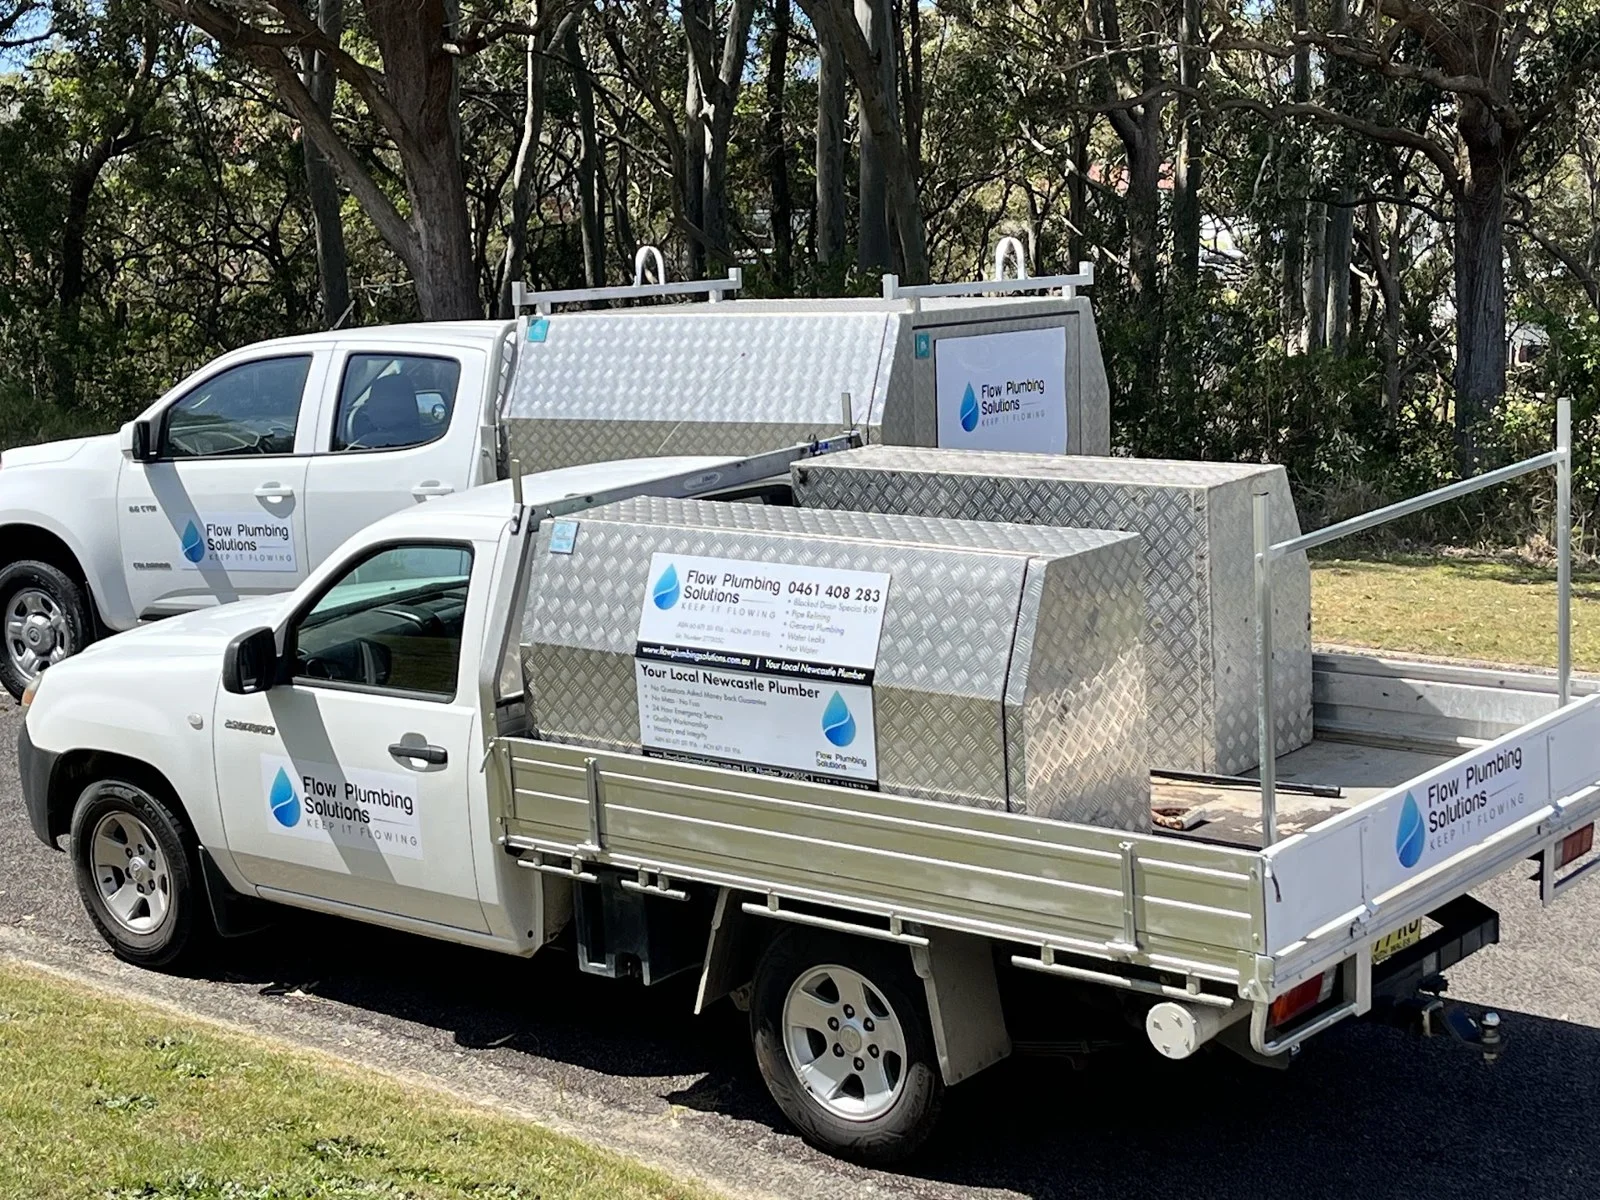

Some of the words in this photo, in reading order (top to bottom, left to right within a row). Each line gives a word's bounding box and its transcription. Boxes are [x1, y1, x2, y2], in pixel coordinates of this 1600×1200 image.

[981, 384, 1002, 399] Flow
[1006, 379, 1045, 395] Plumbing
[981, 398, 1020, 415] Solutions
[206, 524, 232, 537] Flow
[238, 524, 289, 540] Plumbing
[207, 538, 257, 551] Solutions
[249, 554, 292, 562] FLOWING
[686, 570, 717, 585] Flow
[722, 573, 781, 596] Plumbing
[788, 581, 819, 596] 0461
[825, 585, 850, 599] 408
[855, 588, 880, 602] 283
[684, 585, 740, 604] Solutions
[681, 603, 706, 611] KEEP
[711, 604, 720, 612] IT
[727, 607, 776, 619] FLOWING
[816, 623, 845, 636] Plumbing
[765, 659, 781, 669] Your
[781, 661, 800, 672] Local
[801, 664, 836, 676] Newcastle
[837, 668, 866, 680] Plumber
[640, 664, 667, 678] Your
[670, 668, 699, 683] Local
[703, 672, 764, 692] Newcastle
[768, 680, 820, 698] Plumber
[816, 751, 832, 760] Flow
[835, 754, 867, 767] Plumbing
[816, 759, 847, 770] Solutions
[1428, 779, 1459, 808] Flow
[1465, 747, 1522, 789] Plumbing
[303, 776, 336, 797] Flow
[345, 783, 414, 816] Plumbing
[304, 797, 370, 824] Solutions
[1429, 789, 1487, 833] Solutions
[1429, 829, 1456, 850] KEEP
[1462, 821, 1472, 835] IT
[1478, 793, 1525, 828] FLOWING
[306, 818, 334, 831] KEEP
[342, 825, 352, 834] IT
[360, 828, 417, 846] FLOWING
